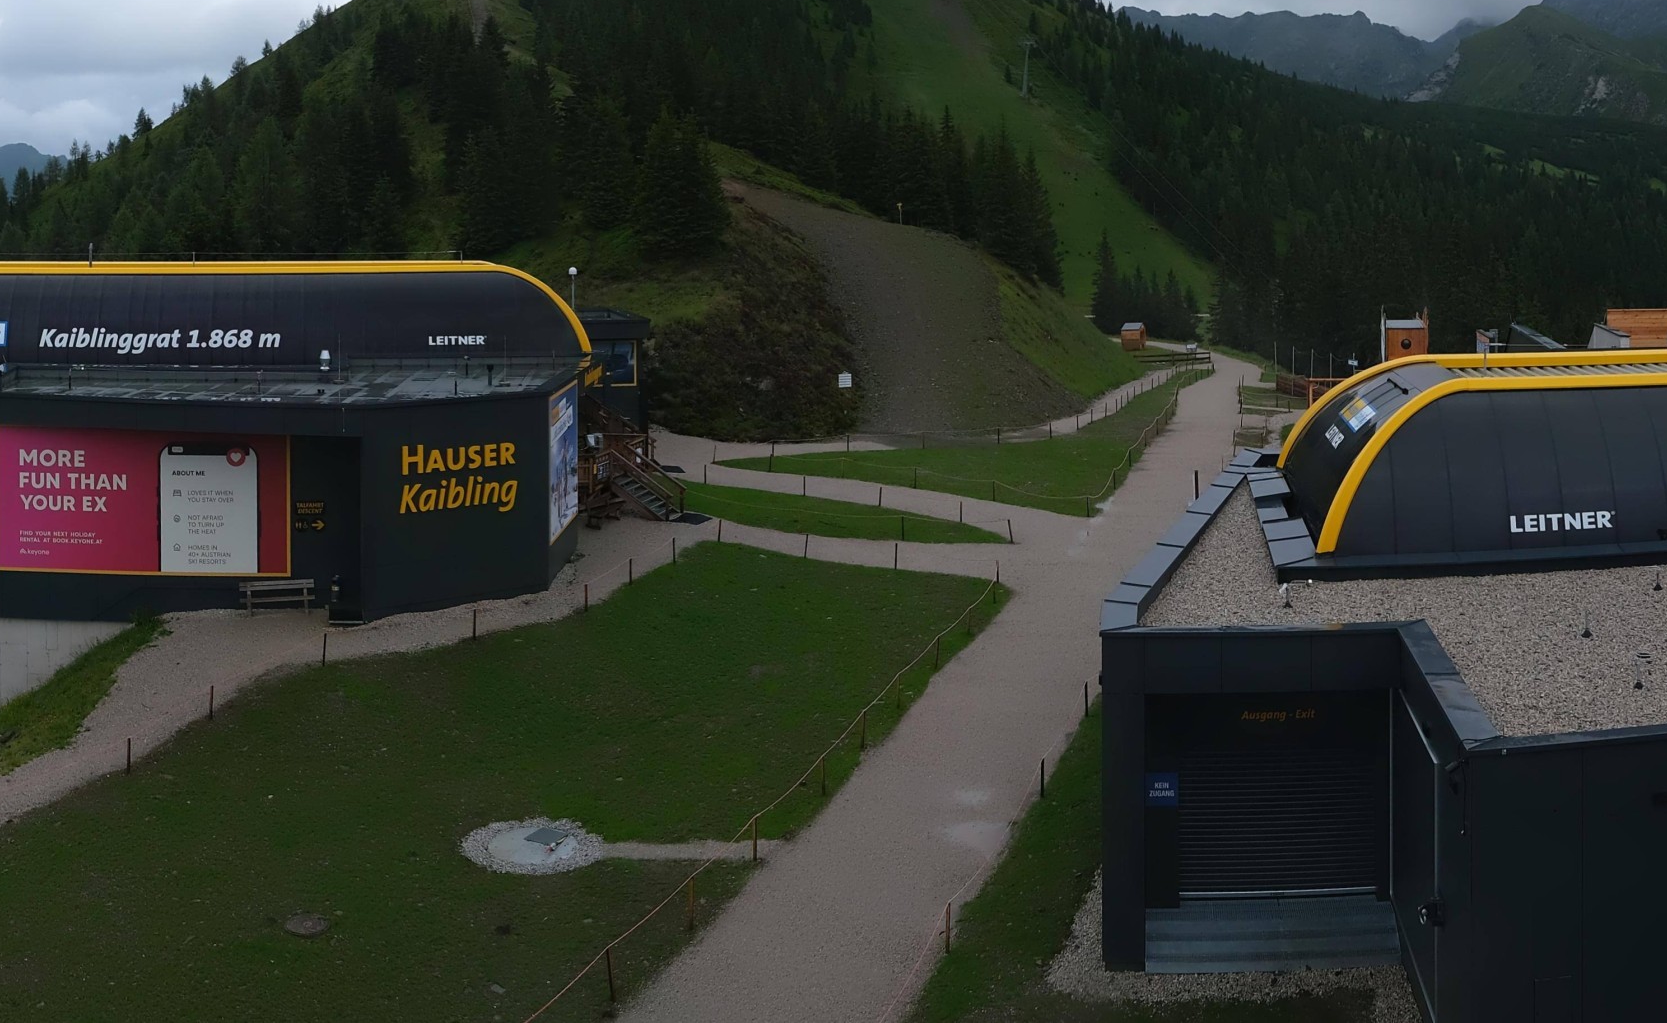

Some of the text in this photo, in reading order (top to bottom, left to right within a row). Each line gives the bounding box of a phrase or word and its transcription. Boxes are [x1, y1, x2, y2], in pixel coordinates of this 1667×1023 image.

[39, 327, 281, 354] Kaiblinggrat 1.868 m
[428, 335, 486, 346] LEITNER
[19, 449, 85, 467] MORE
[402, 442, 516, 475] HAUSER
[19, 472, 127, 490] FUN THAN
[20, 495, 107, 512] YOUR EX
[399, 476, 518, 514] Kaibling
[1509, 510, 1613, 533] LEITNER
[1241, 710, 1287, 722] Ausgang
[1295, 709, 1316, 719] Exit
[1149, 789, 1175, 797] ZUGANG
